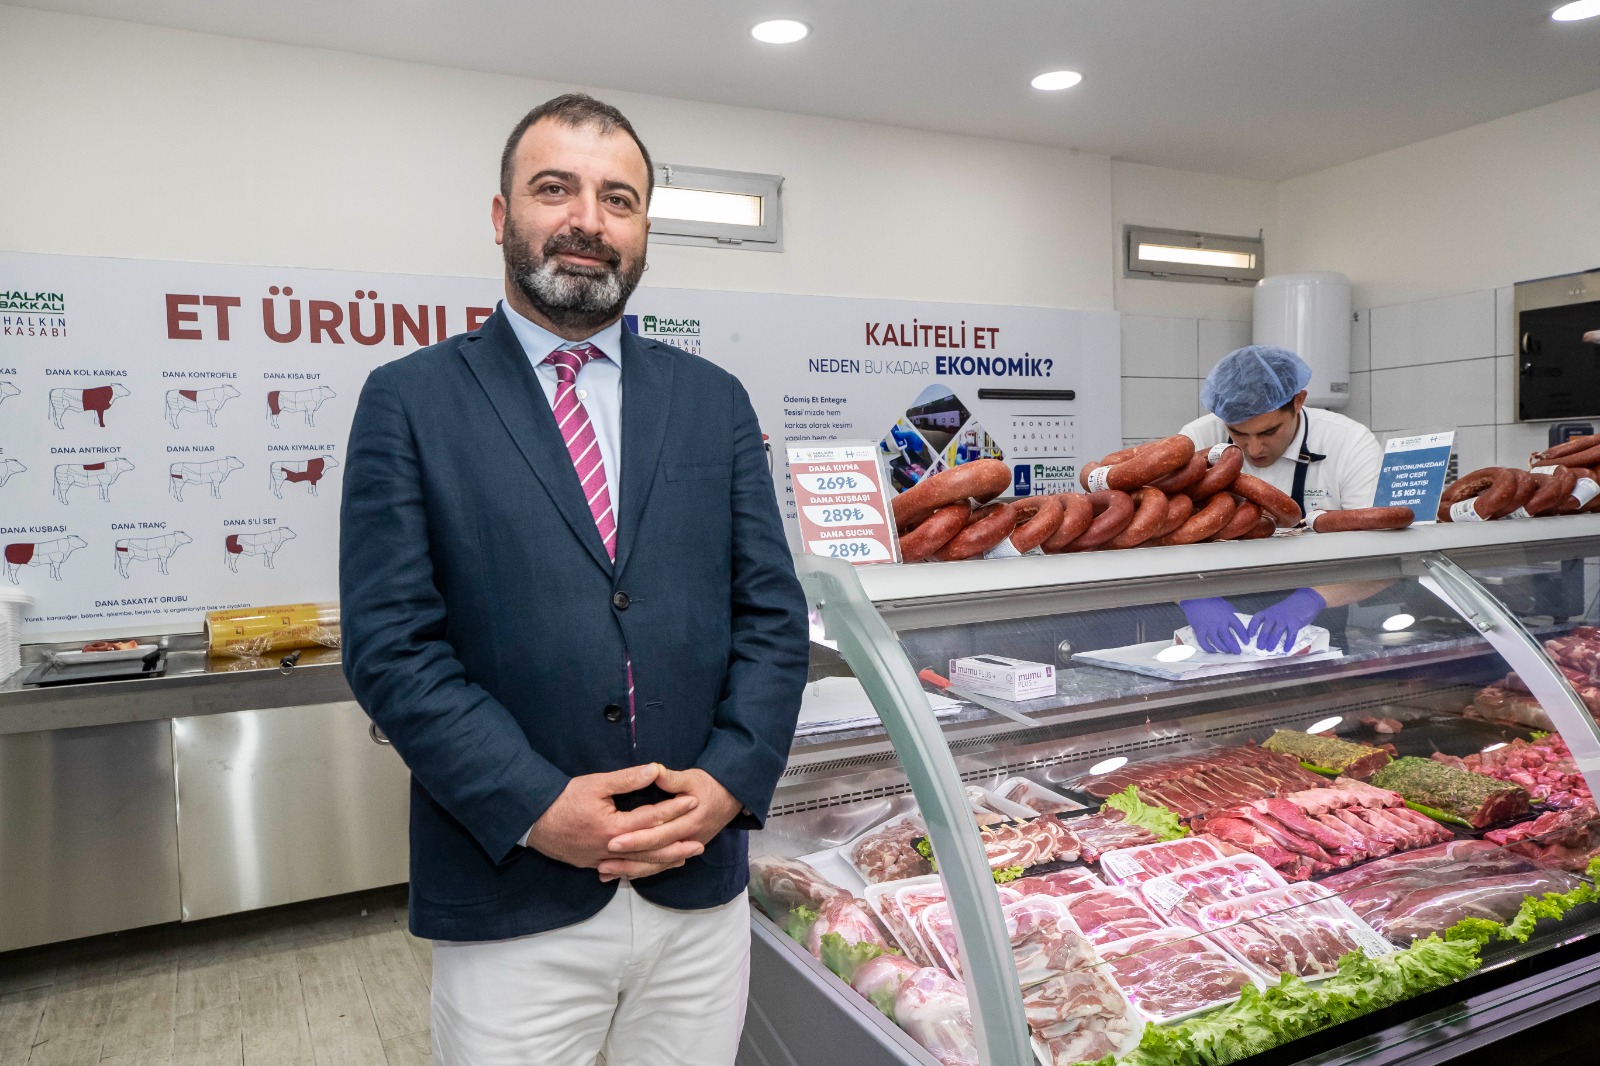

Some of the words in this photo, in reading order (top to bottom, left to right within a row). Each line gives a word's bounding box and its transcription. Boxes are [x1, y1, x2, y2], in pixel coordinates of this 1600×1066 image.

[0, 290, 64, 302] HALKIN
[3, 316, 66, 327] HALKIN
[165, 293, 241, 341] ET
[660, 318, 700, 327] HALKIN
[4, 326, 67, 337] KASABI
[660, 326, 700, 334] BAKKALI
[865, 318, 966, 349] KALİTELİ
[973, 326, 1000, 350] ET
[662, 338, 701, 346] HALKIN
[808, 358, 860, 374] NEDEN
[864, 359, 883, 374] BU
[885, 360, 929, 375] KADAR
[935, 352, 1053, 377] EKONOMİK?
[45, 368, 72, 376] DANA
[93, 369, 128, 377] KARKAS
[188, 370, 238, 379] KONTROFİLE
[783, 395, 810, 404] Ödemiş
[811, 396, 819, 404] Et
[820, 396, 847, 405] Entegre
[784, 408, 825, 416] Tesisi'mizde
[808, 421, 831, 429] olarak
[832, 421, 853, 429] kesimi
[78, 445, 121, 453] ANTRİKOT
[166, 445, 191, 453] DANA
[808, 464, 832, 472] DANA
[833, 463, 859, 471] KIYMA
[1045, 465, 1075, 473] HALKIN
[1391, 460, 1446, 472] REYONUMUZDAKİ
[1409, 471, 1428, 479] ÇEŞİT
[816, 476, 858, 491] 269₺
[1047, 481, 1075, 489] HALKIN
[1409, 480, 1429, 488] SATIŞI
[1391, 489, 1403, 498] 1,5
[1404, 489, 1416, 497] KG
[810, 496, 834, 504] DANA
[835, 494, 871, 503] KUŞBAŞI
[822, 508, 865, 523] 289₺
[0, 526, 27, 534] DANA
[29, 525, 67, 533] KUŞBAŞI
[138, 521, 167, 529] TRANÇ
[820, 530, 845, 538] DANA
[845, 528, 875, 537] SUCUK
[828, 542, 871, 558] 289₺
[121, 597, 158, 606] SAKATAT
[160, 595, 188, 603] GRUBU
